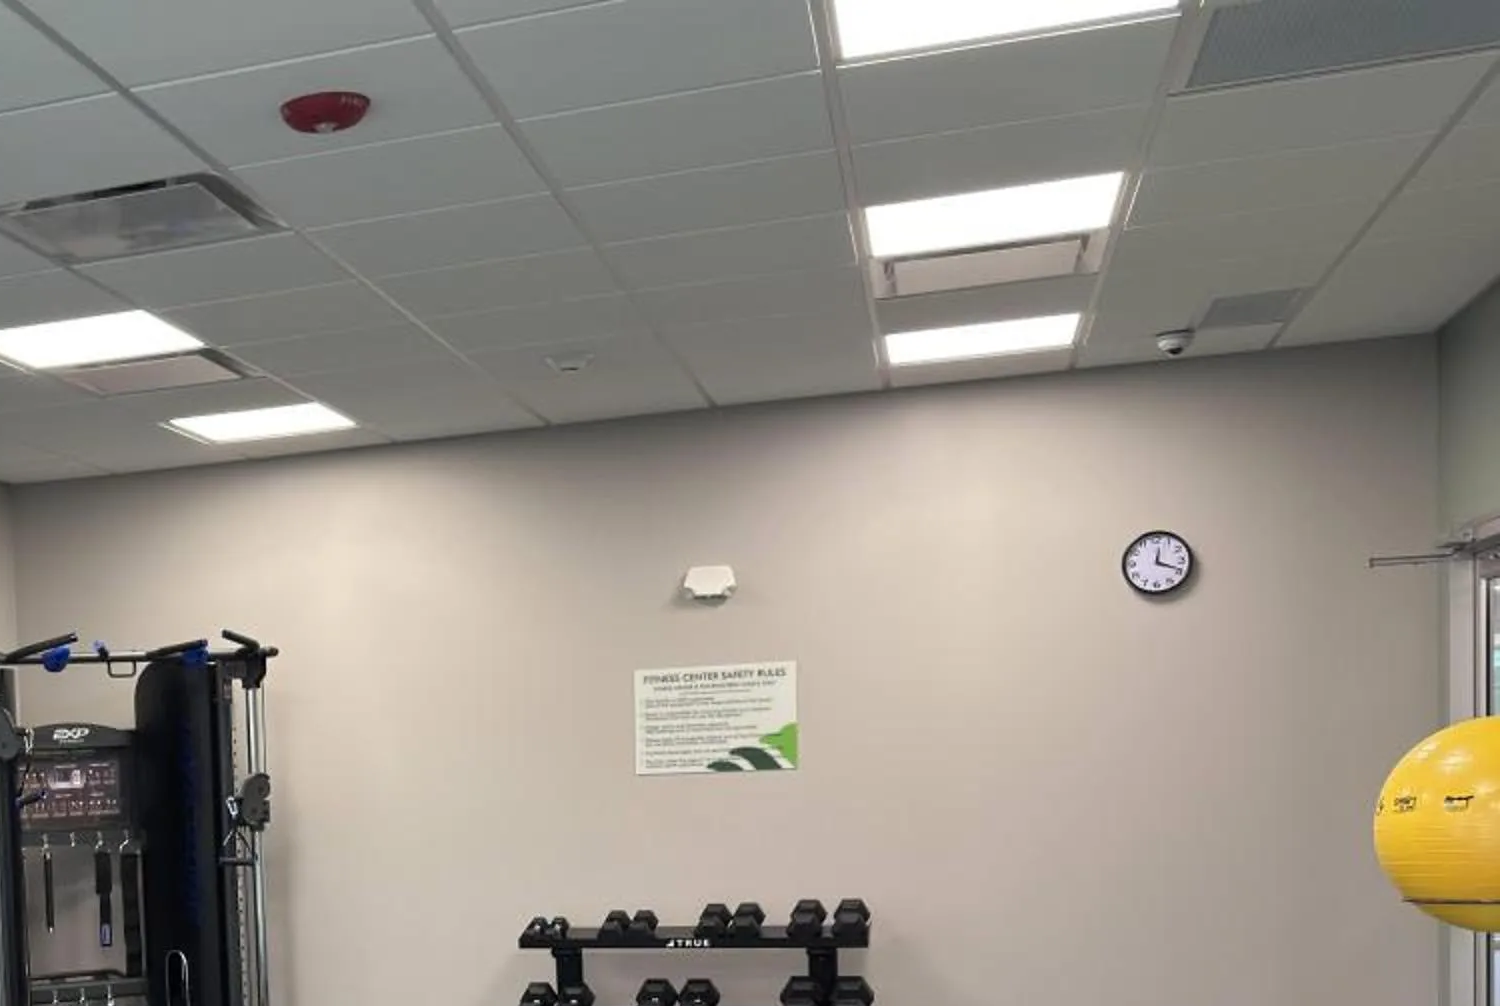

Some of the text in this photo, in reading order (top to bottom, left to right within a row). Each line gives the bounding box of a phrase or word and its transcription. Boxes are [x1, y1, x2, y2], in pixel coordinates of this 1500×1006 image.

[682, 671, 718, 683] CENTER
[721, 669, 754, 681] SAFETY
[676, 939, 711, 947] TRUE
